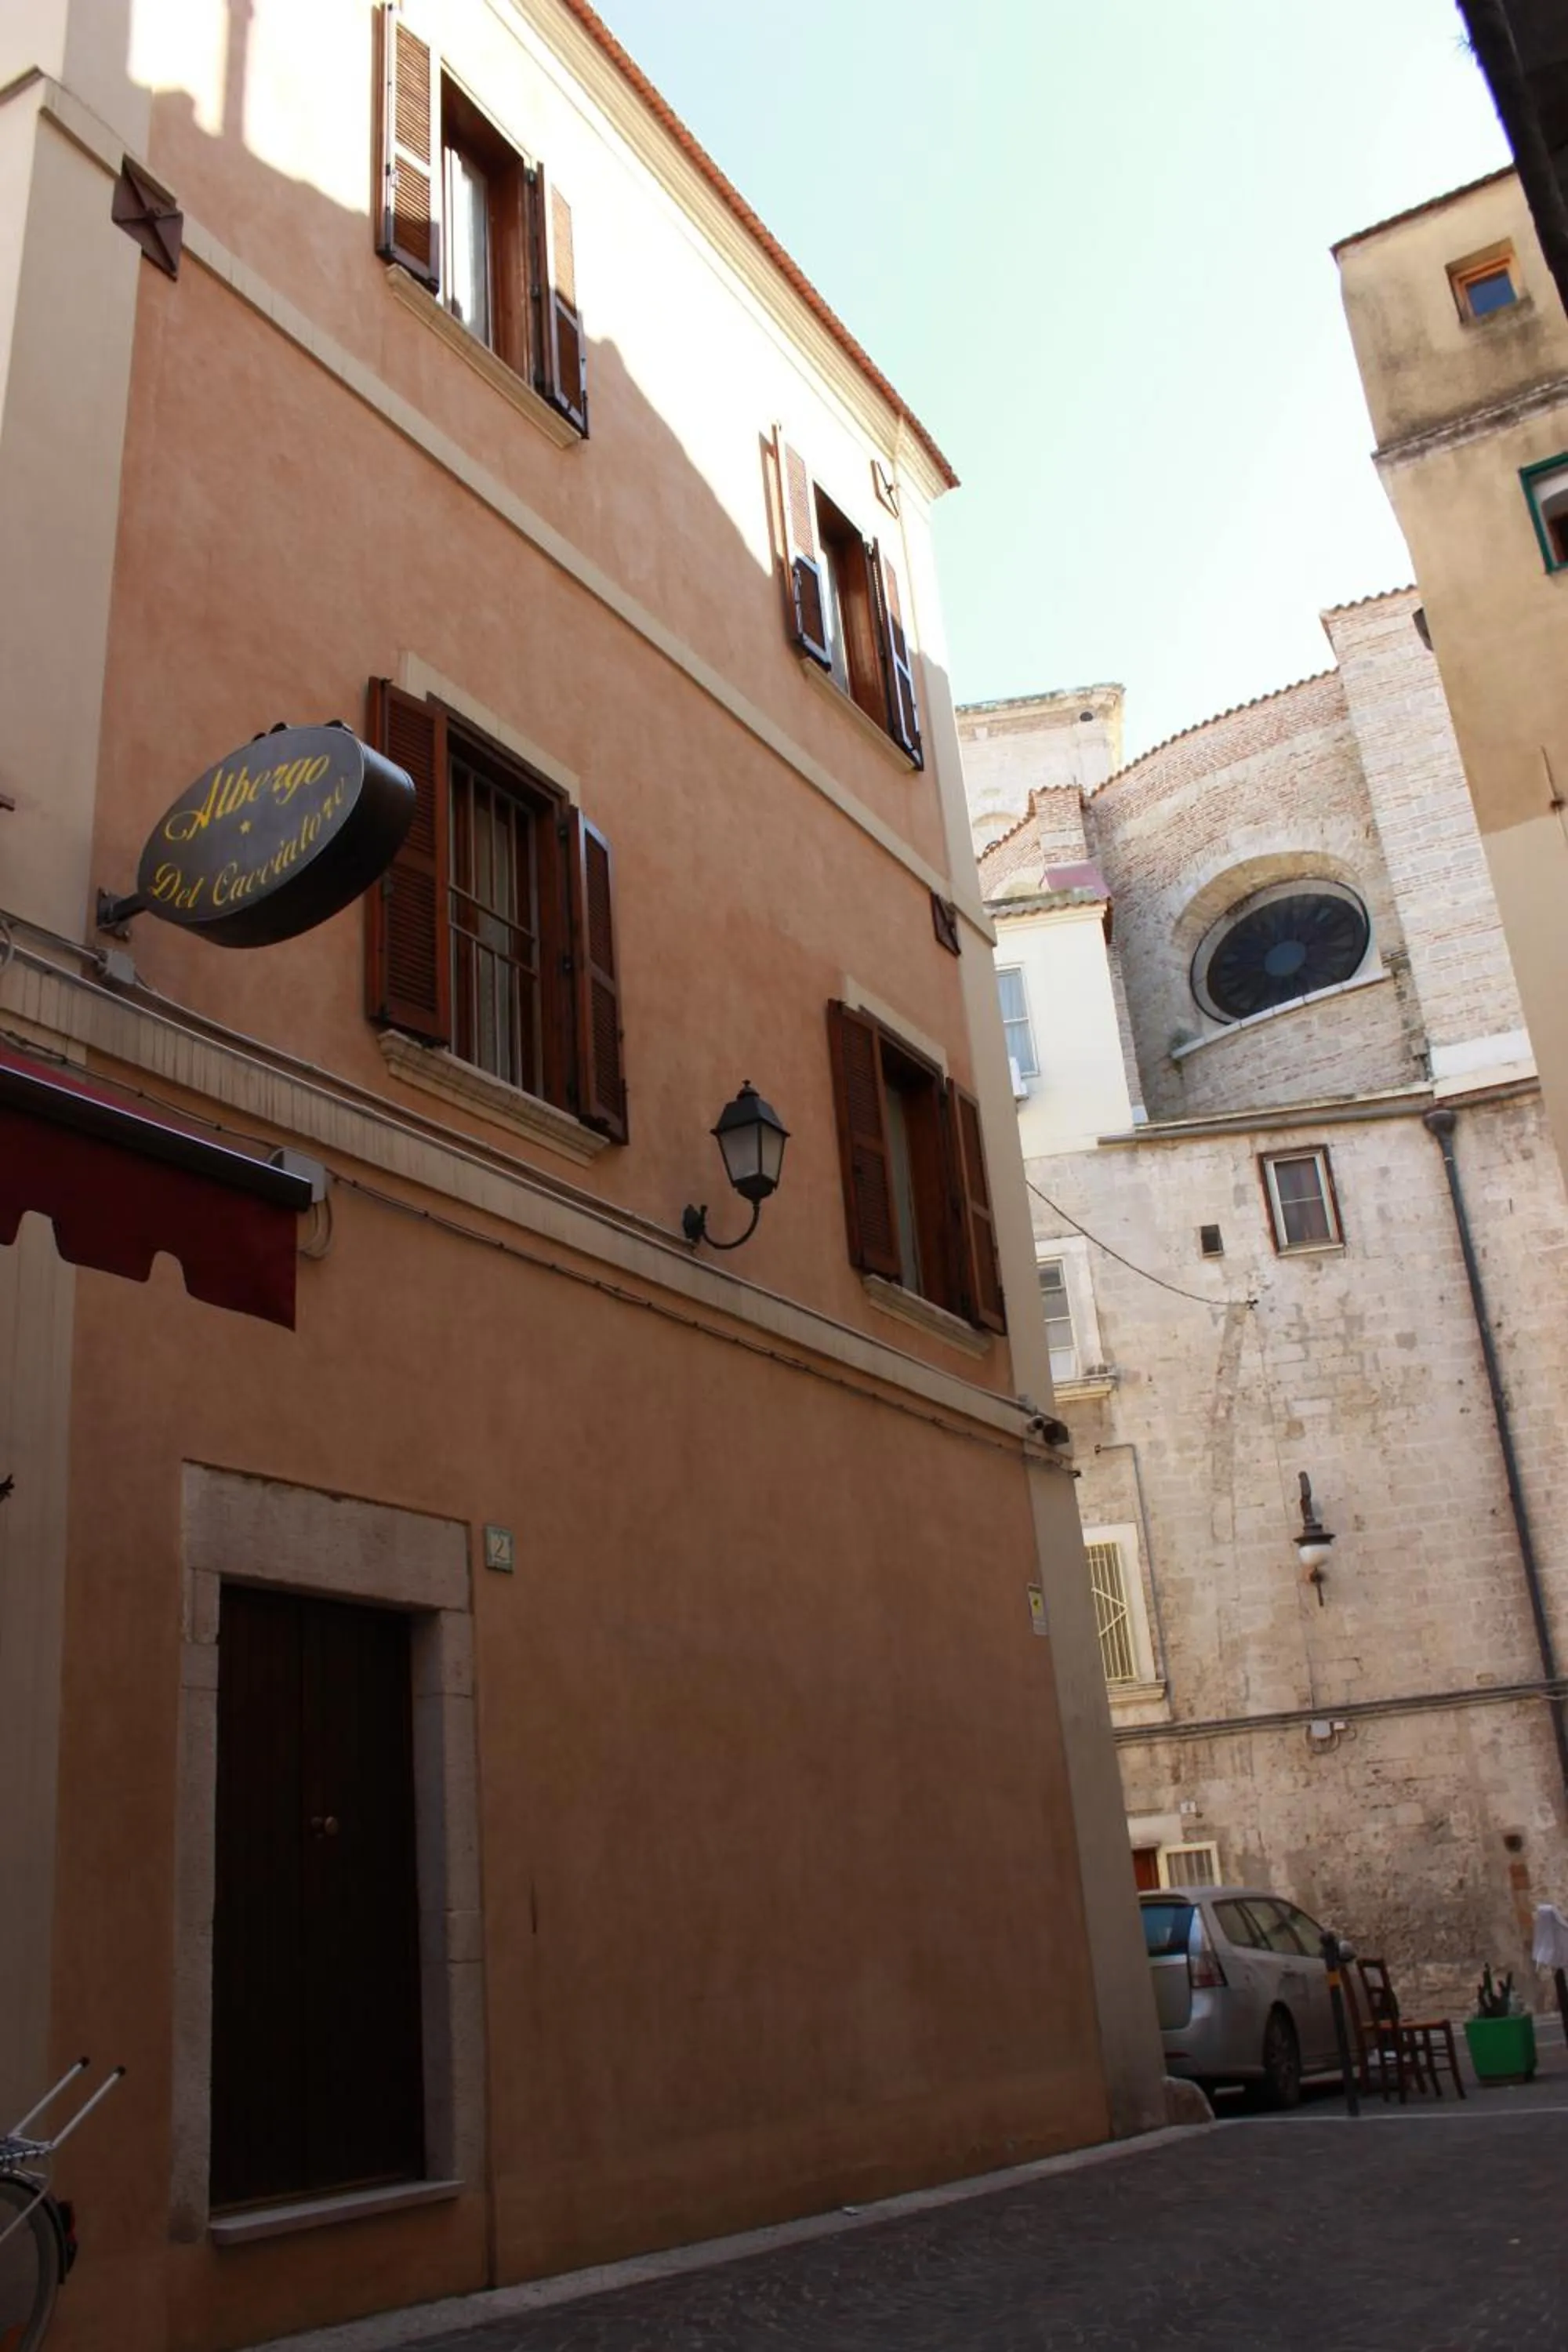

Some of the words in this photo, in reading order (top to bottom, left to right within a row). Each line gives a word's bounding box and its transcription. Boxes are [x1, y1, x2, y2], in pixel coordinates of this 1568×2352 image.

[152, 862, 205, 909] Del
[212, 776, 346, 906] Cacciatore
[163, 754, 330, 841] Albergo
